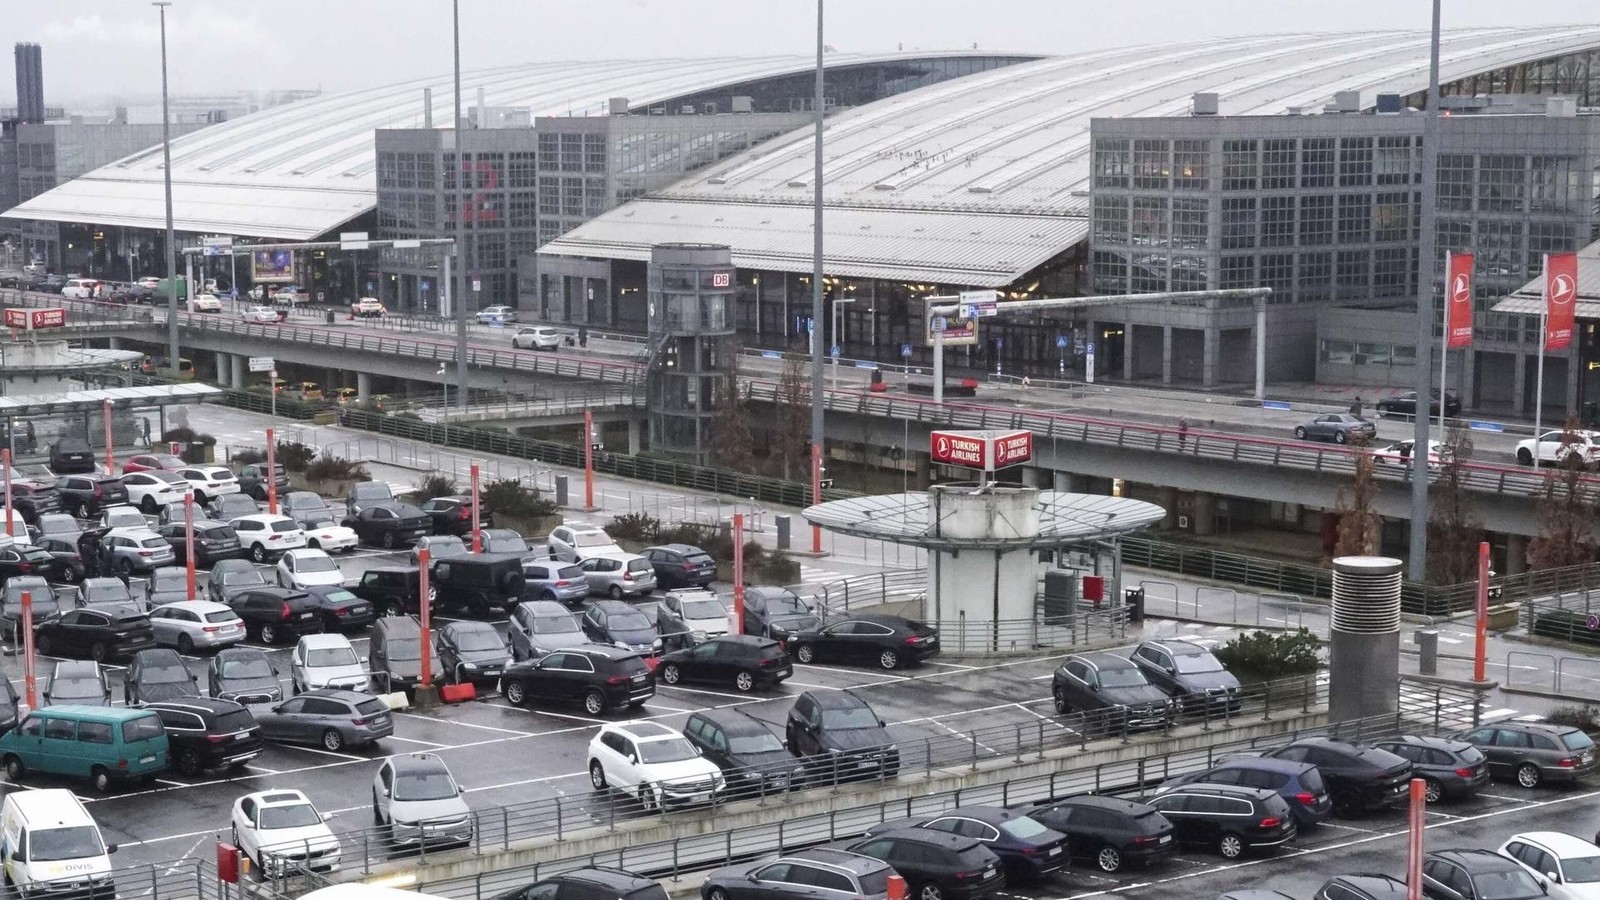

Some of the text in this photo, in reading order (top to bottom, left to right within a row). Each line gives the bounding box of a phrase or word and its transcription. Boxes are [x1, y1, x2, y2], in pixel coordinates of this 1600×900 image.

[715, 275, 728, 285] DB
[951, 439, 980, 453] TURKISH
[1007, 437, 1028, 449] TURKISH
[951, 449, 980, 462] AIRLINES
[1007, 447, 1028, 460] AIRLINES
